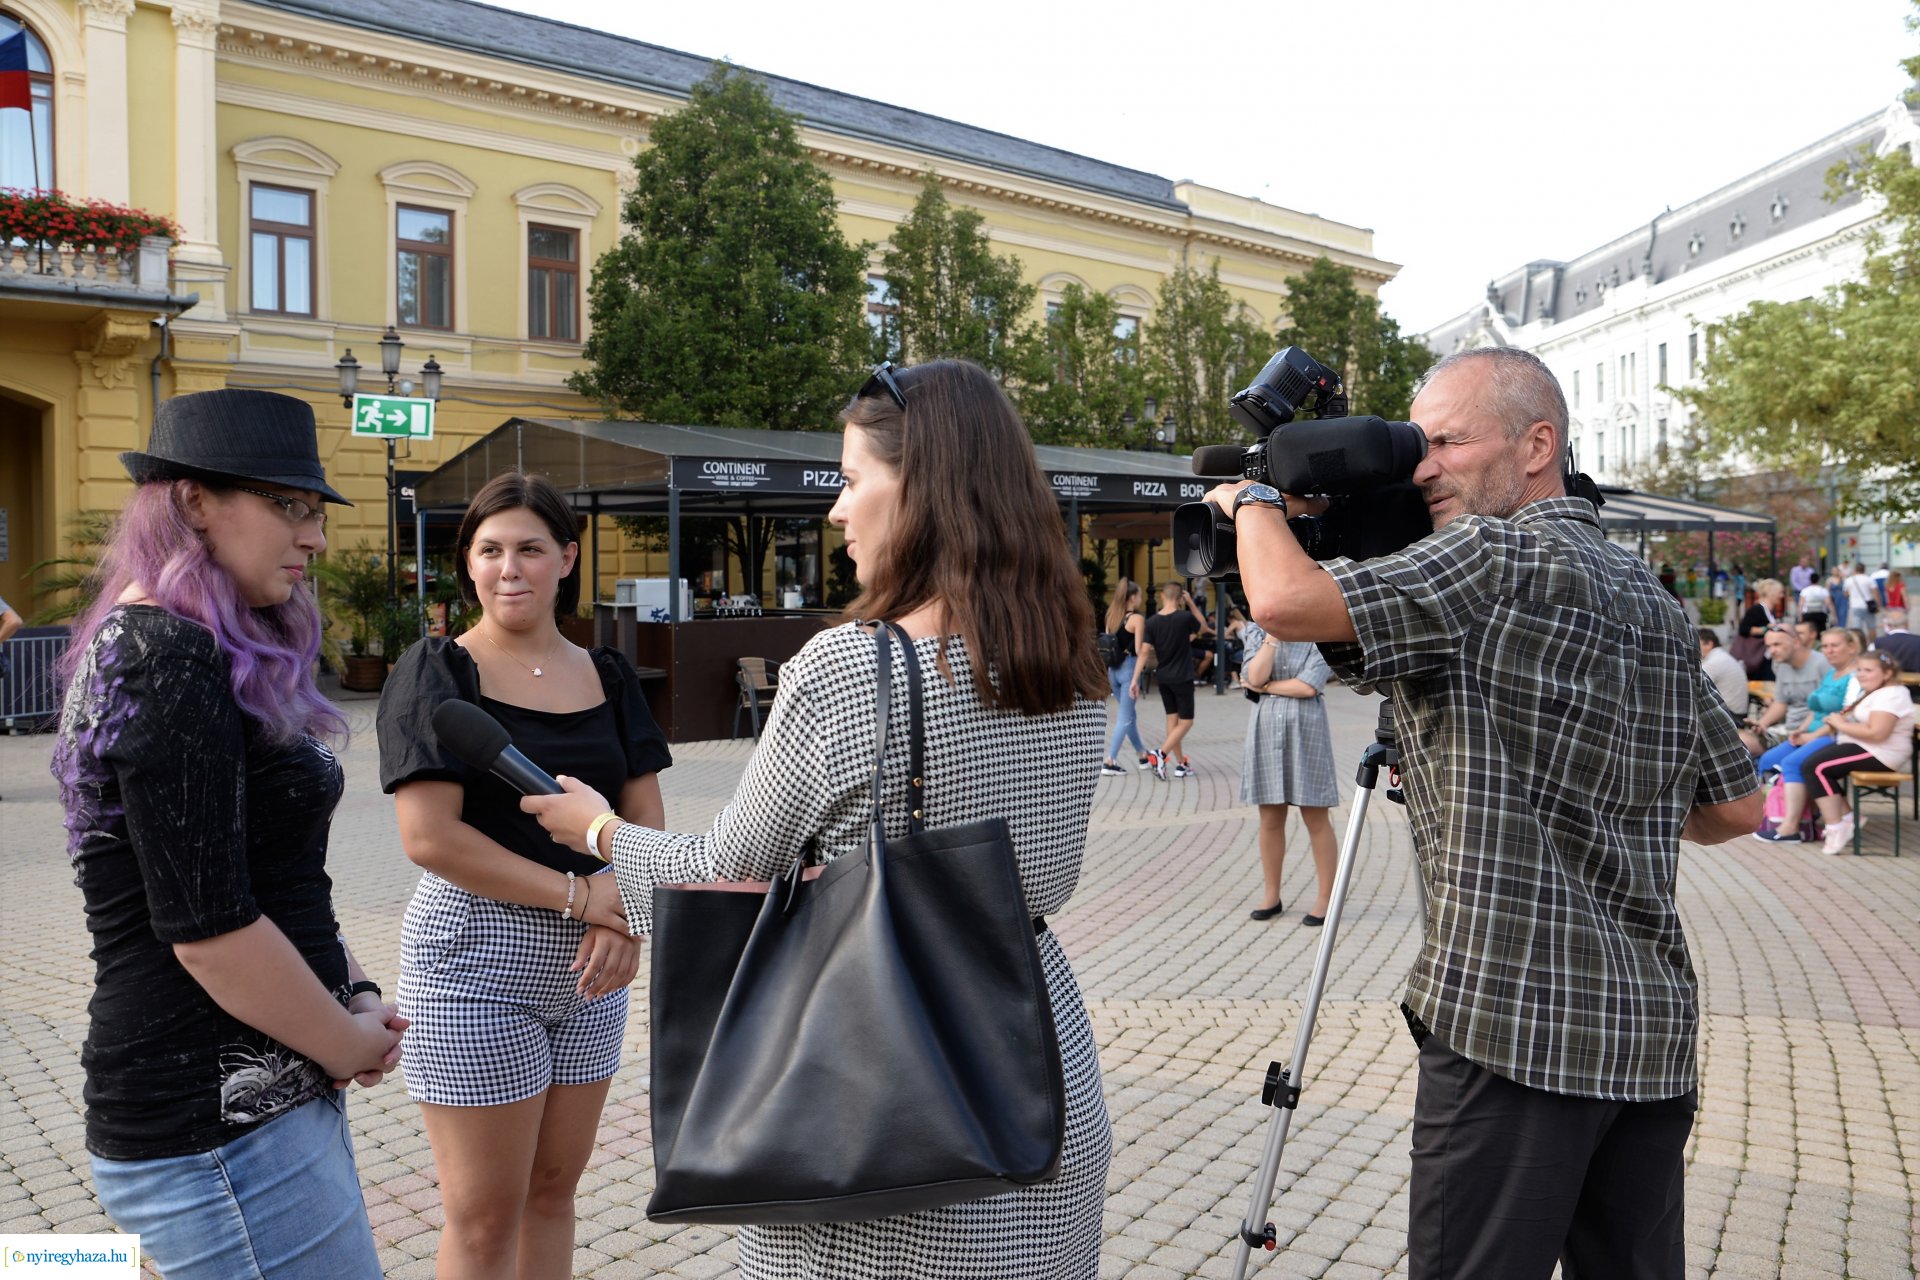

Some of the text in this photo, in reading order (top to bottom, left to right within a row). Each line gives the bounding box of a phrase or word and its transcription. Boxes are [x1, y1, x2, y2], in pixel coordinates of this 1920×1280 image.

[703, 461, 767, 475] CONTINENT
[1053, 474, 1098, 487] CONTINENT
[1133, 482, 1205, 498] PIZZA BOR
